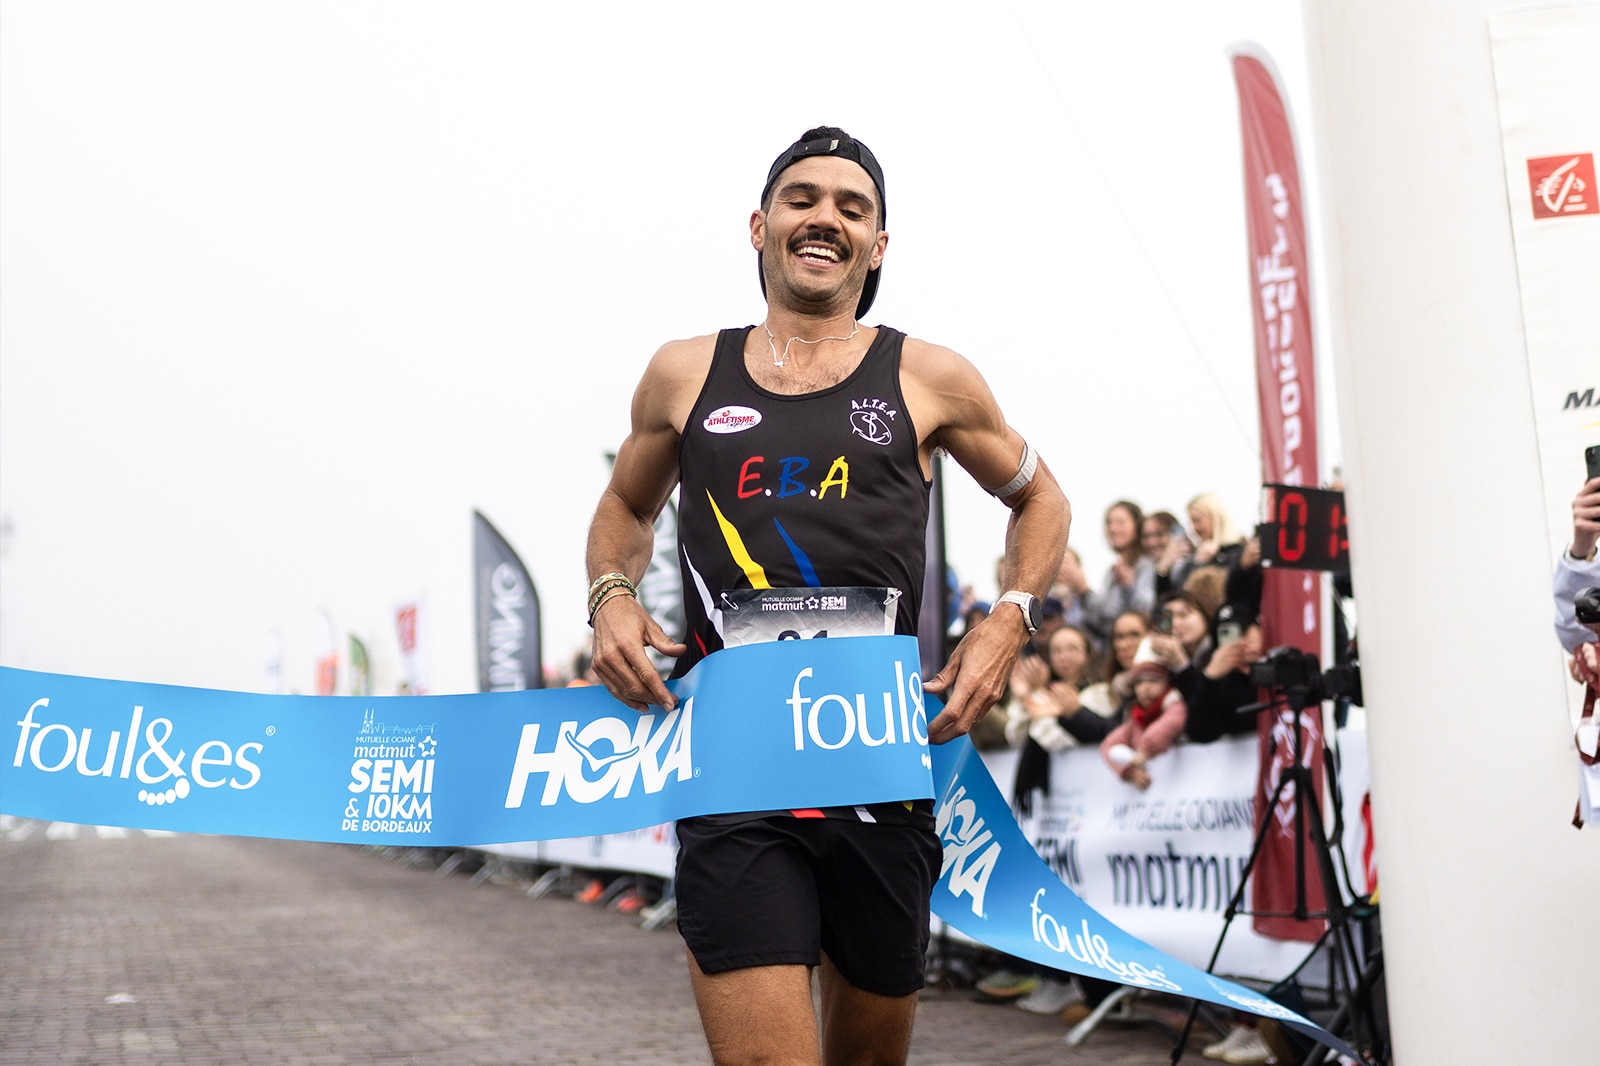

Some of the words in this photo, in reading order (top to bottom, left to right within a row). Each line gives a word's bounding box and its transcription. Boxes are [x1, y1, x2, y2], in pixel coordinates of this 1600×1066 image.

[737, 456, 849, 499] E.B.A
[761, 601, 805, 612] matmut
[821, 596, 847, 607] SEMI
[355, 736, 390, 744] MUTUELLE
[390, 736, 417, 744] OCIANE
[353, 743, 416, 759] matmut
[504, 696, 695, 809] HOKA
[347, 758, 436, 794] SEMI
[344, 797, 360, 819] &
[341, 818, 360, 832] DE
[361, 818, 433, 834] BORDEAUX
